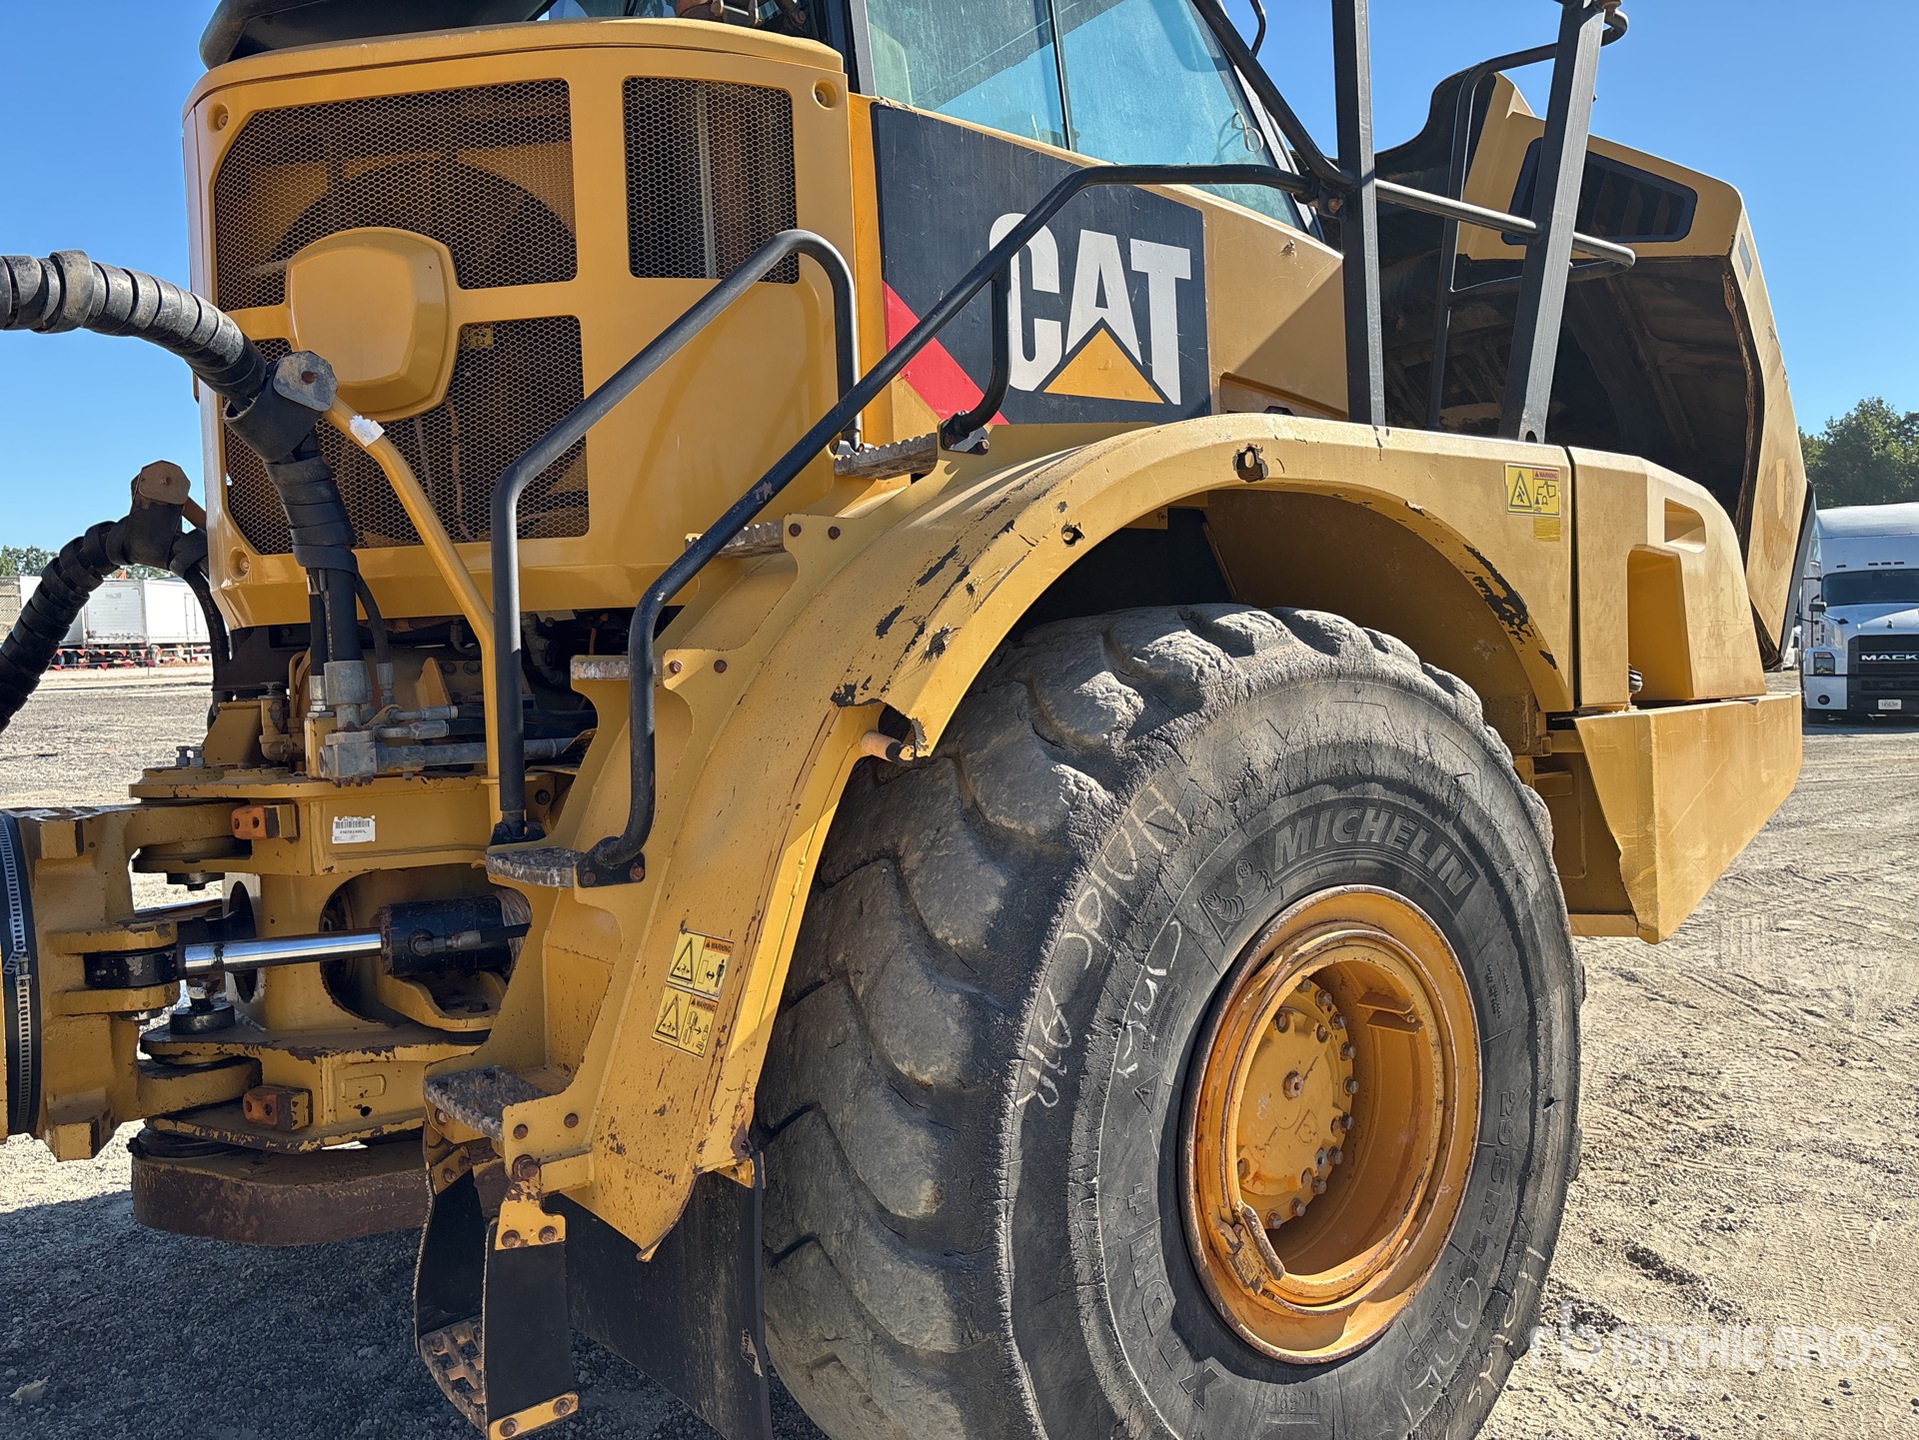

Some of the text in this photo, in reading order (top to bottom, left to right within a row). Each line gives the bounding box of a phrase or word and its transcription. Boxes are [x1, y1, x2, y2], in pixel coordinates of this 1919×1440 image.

[989, 212, 1192, 405] CAT
[1861, 653, 1919, 661] MACK
[1273, 806, 1474, 897] MICHELIN
